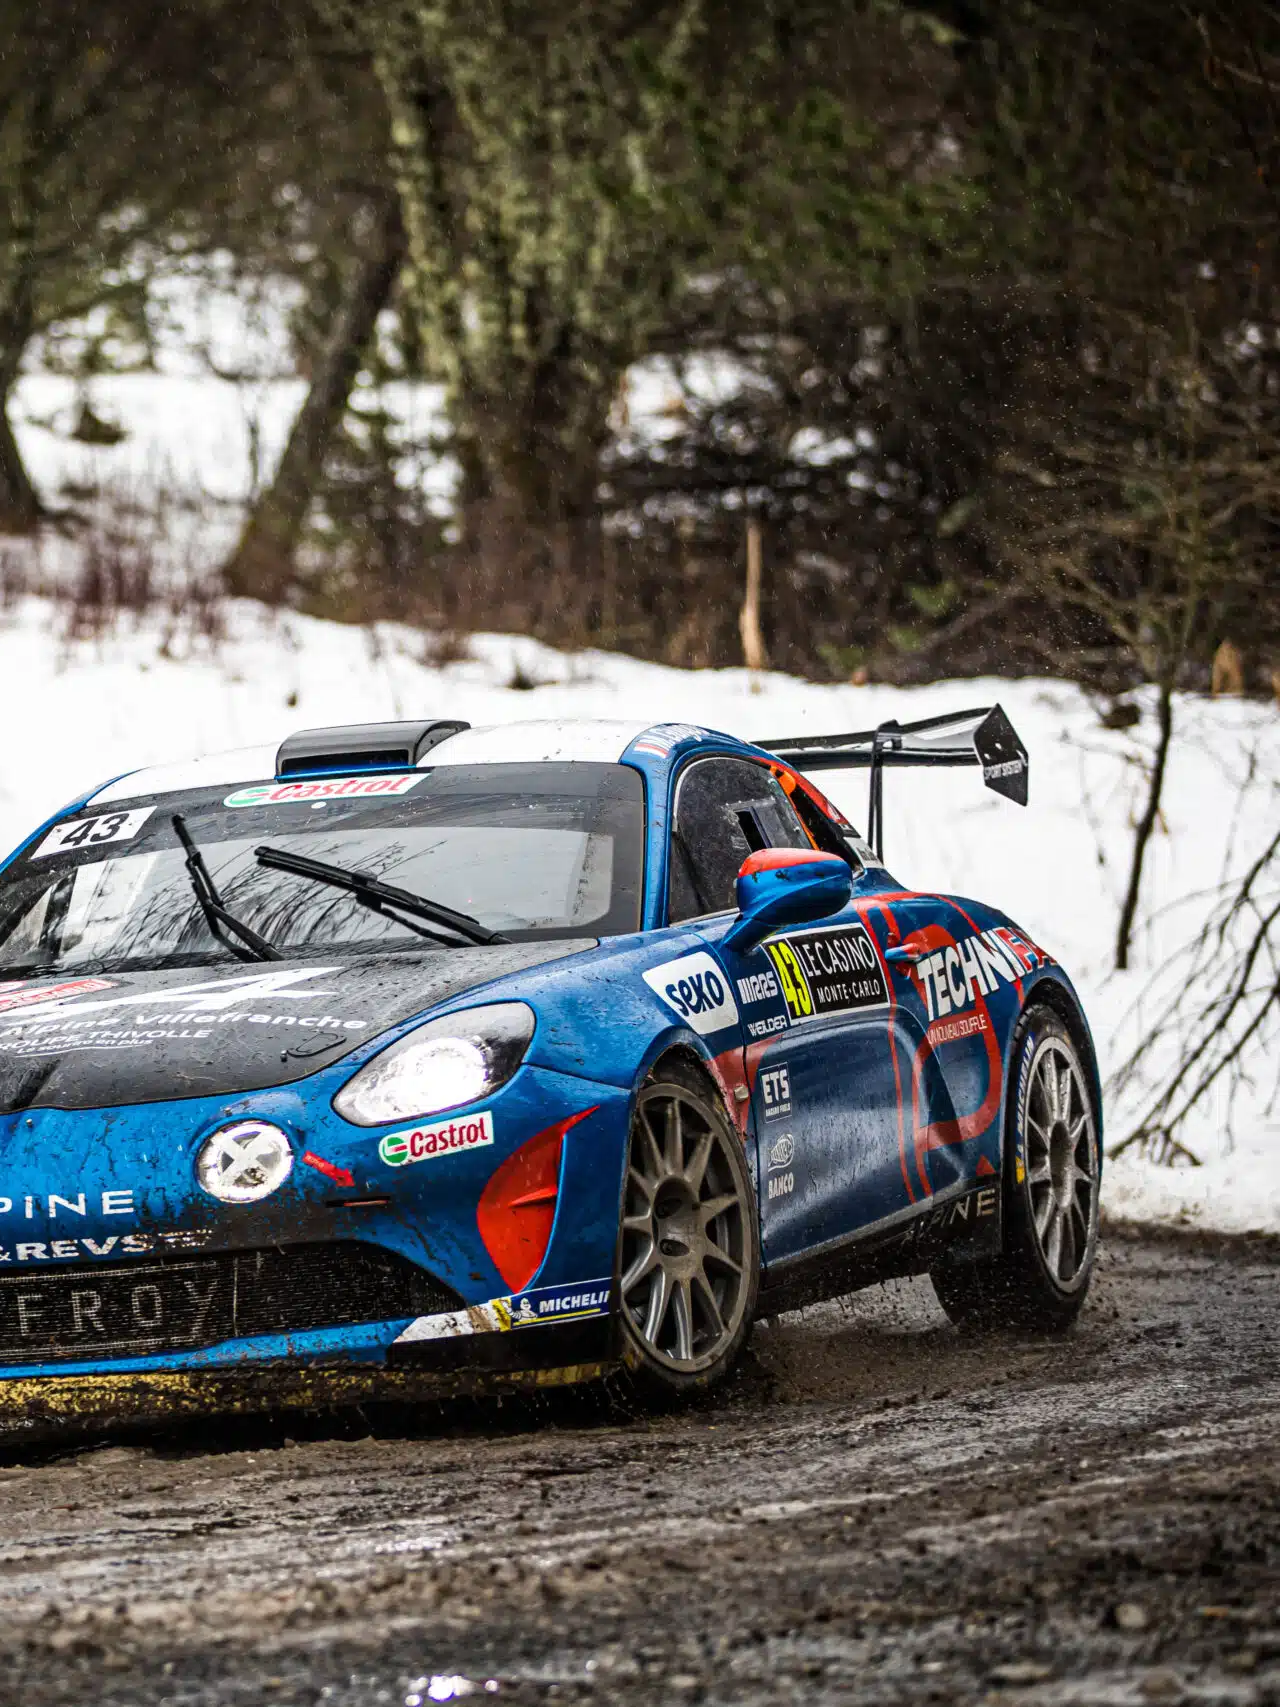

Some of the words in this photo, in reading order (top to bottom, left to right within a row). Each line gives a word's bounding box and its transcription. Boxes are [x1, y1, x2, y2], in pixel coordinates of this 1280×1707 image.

[269, 774, 411, 802] Castrol
[59, 813, 130, 846] 43
[795, 944, 821, 977] LE
[815, 936, 876, 975] CASINO
[769, 941, 812, 1016] 43
[89, 1029, 214, 1040] THIVOLLE
[136, 1011, 368, 1029] Villefranche
[747, 1015, 788, 1037] WELDER
[761, 1069, 790, 1104] ETS
[410, 1117, 488, 1157] Castrol
